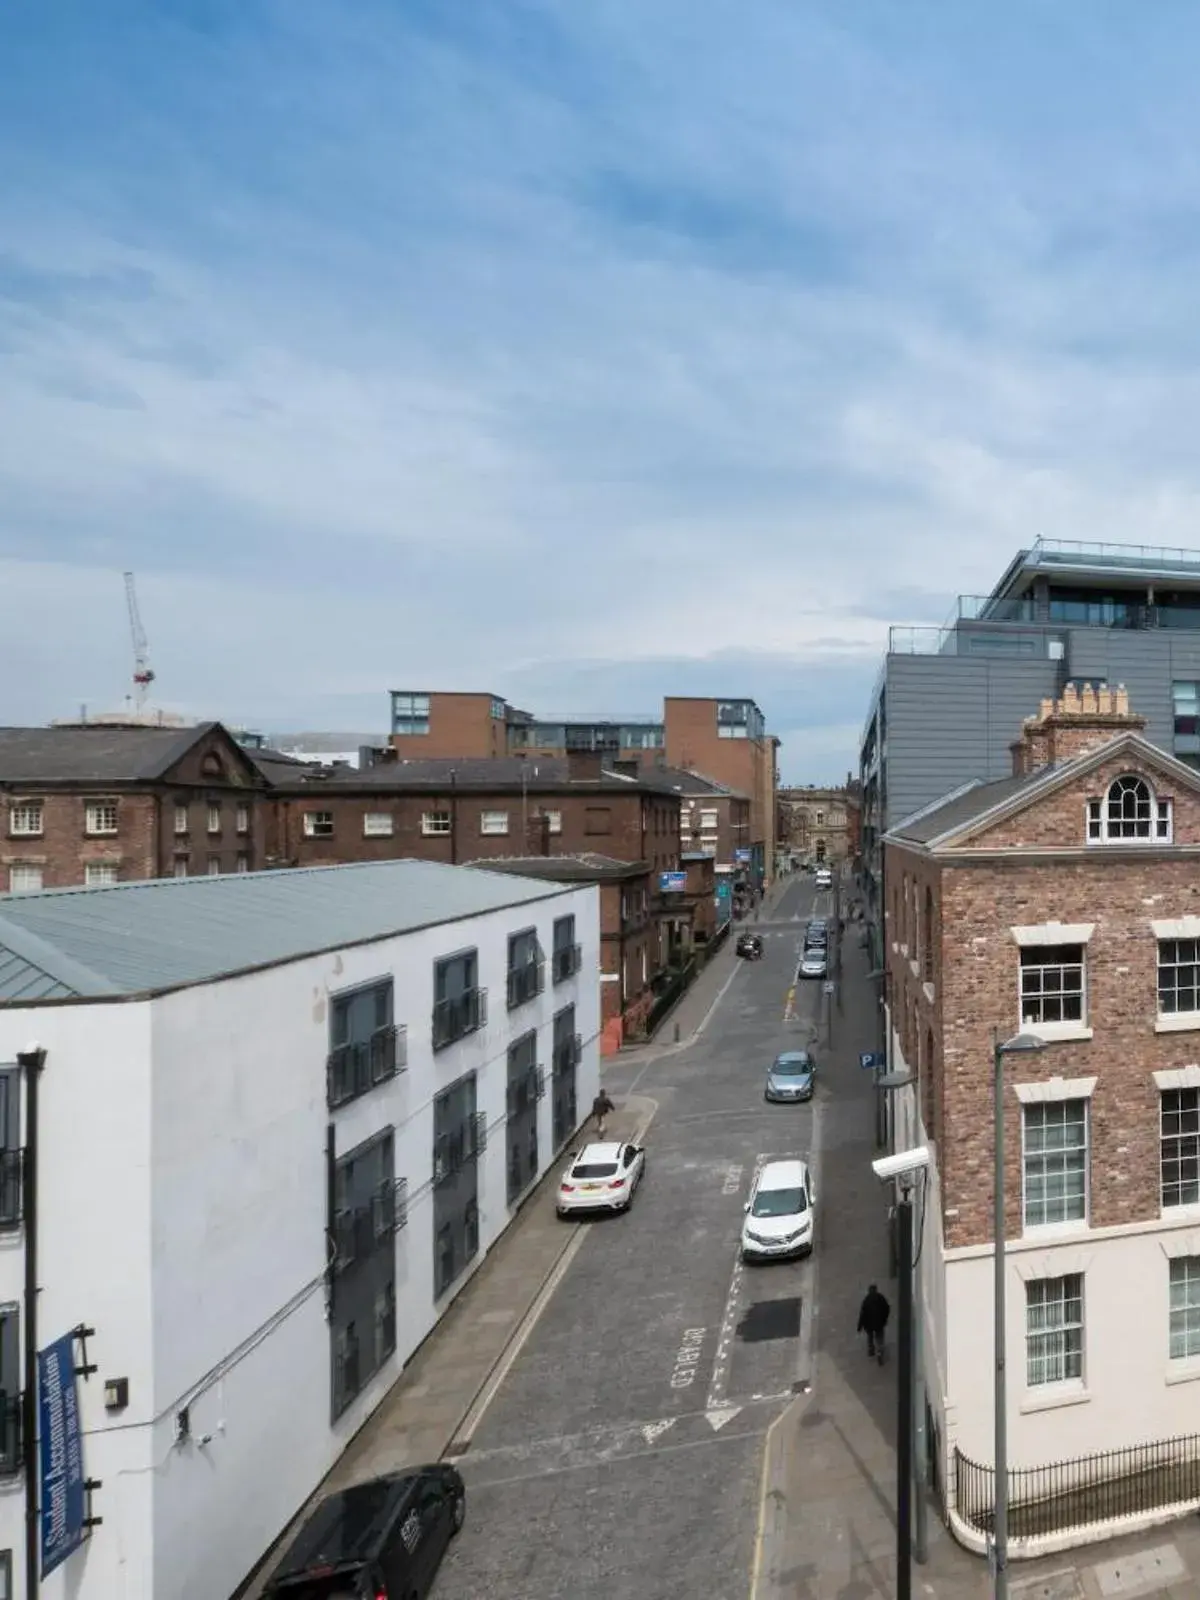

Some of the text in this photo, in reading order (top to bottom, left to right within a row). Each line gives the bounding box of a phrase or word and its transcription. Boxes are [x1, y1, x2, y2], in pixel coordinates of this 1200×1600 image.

[862, 1055, 873, 1067] P
[671, 1327, 706, 1389] DISABLED
[43, 1353, 65, 1480] Accommodation
[45, 1477, 66, 1547] Student
